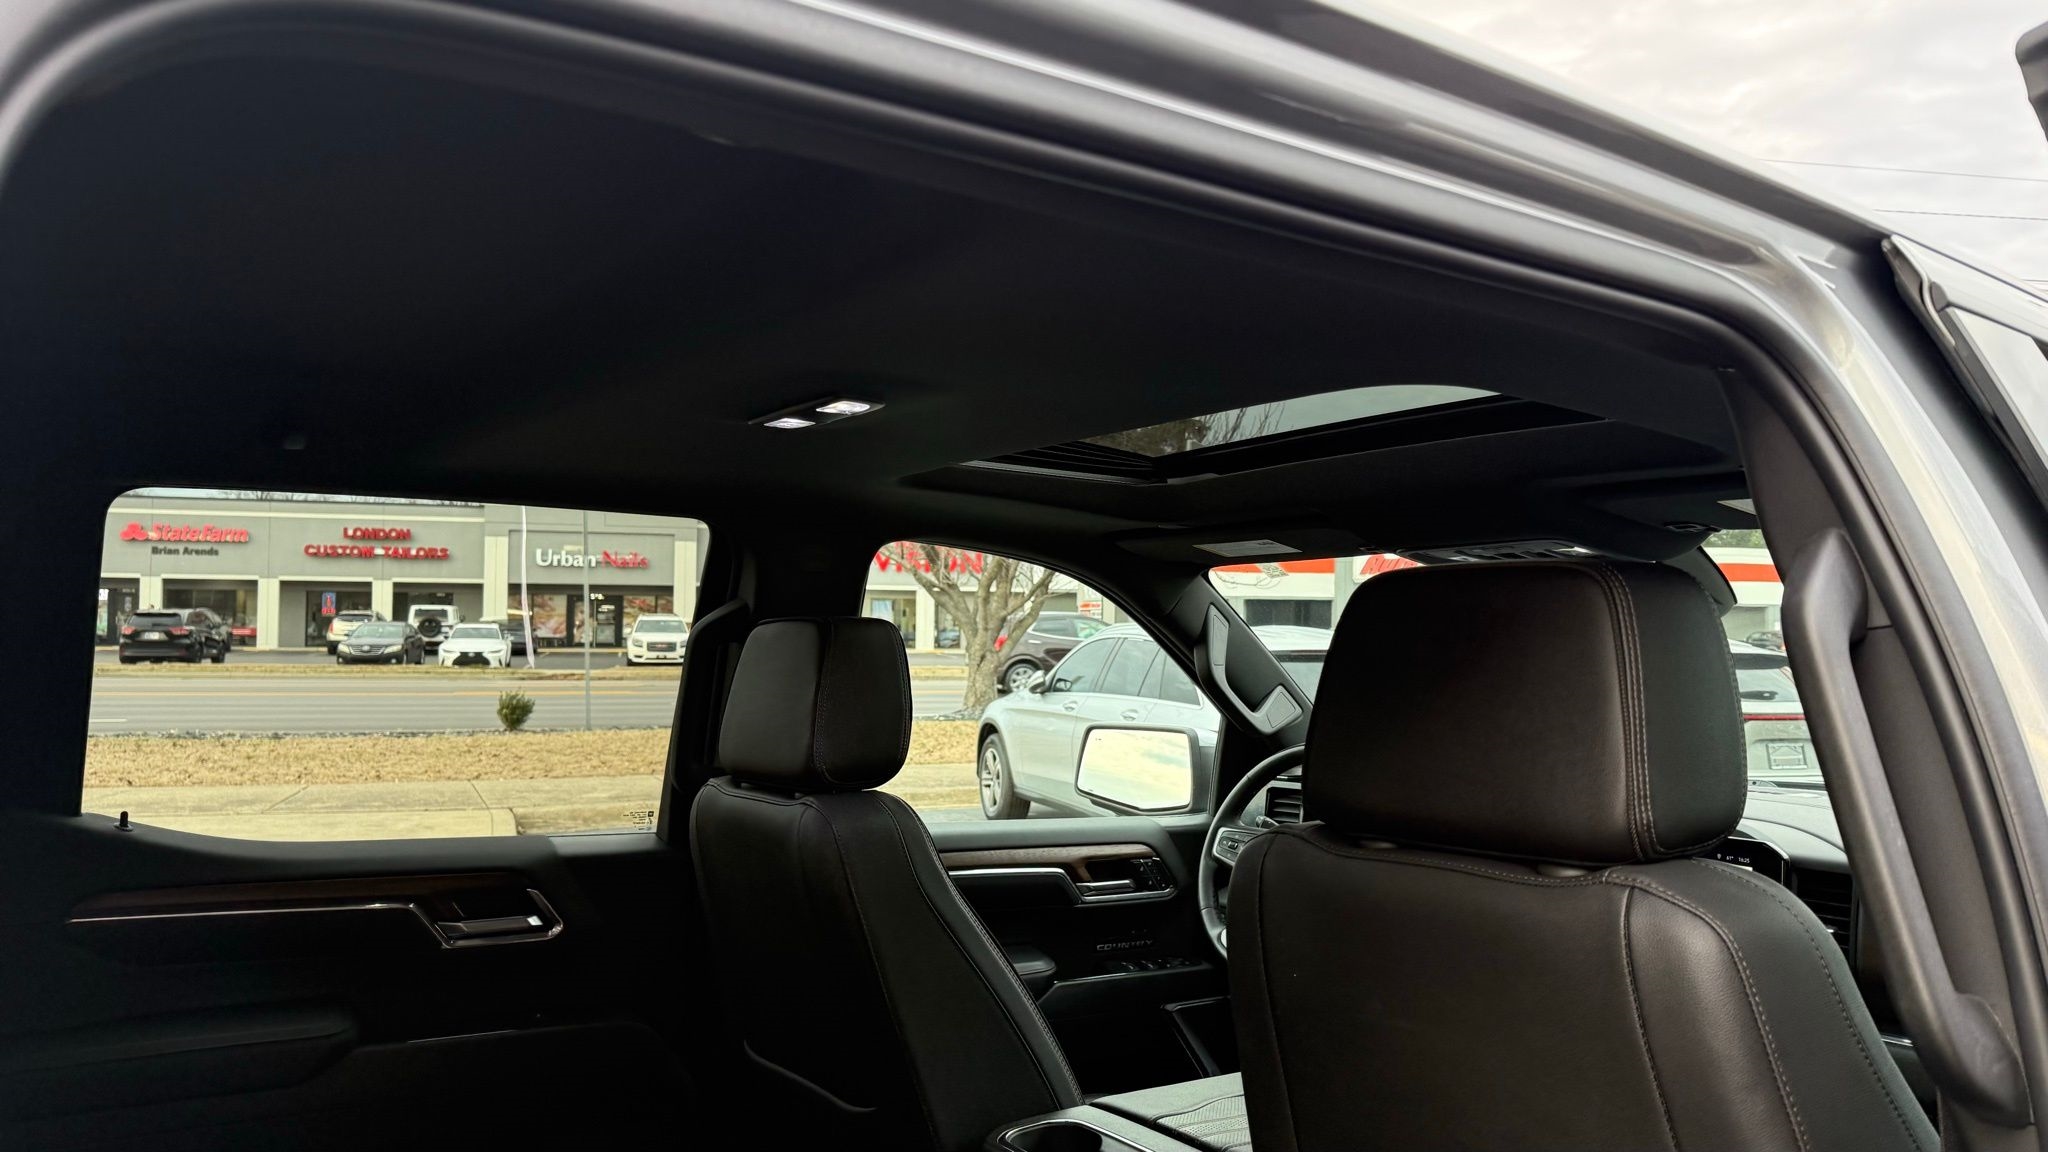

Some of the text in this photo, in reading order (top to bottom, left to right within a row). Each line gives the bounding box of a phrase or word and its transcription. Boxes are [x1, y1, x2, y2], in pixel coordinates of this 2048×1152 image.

[343, 527, 412, 540] LONDON
[151, 546, 219, 556] Brian Arends
[304, 544, 450, 559] CUSTOM TAILORS
[536, 548, 649, 568] Urban Nails
